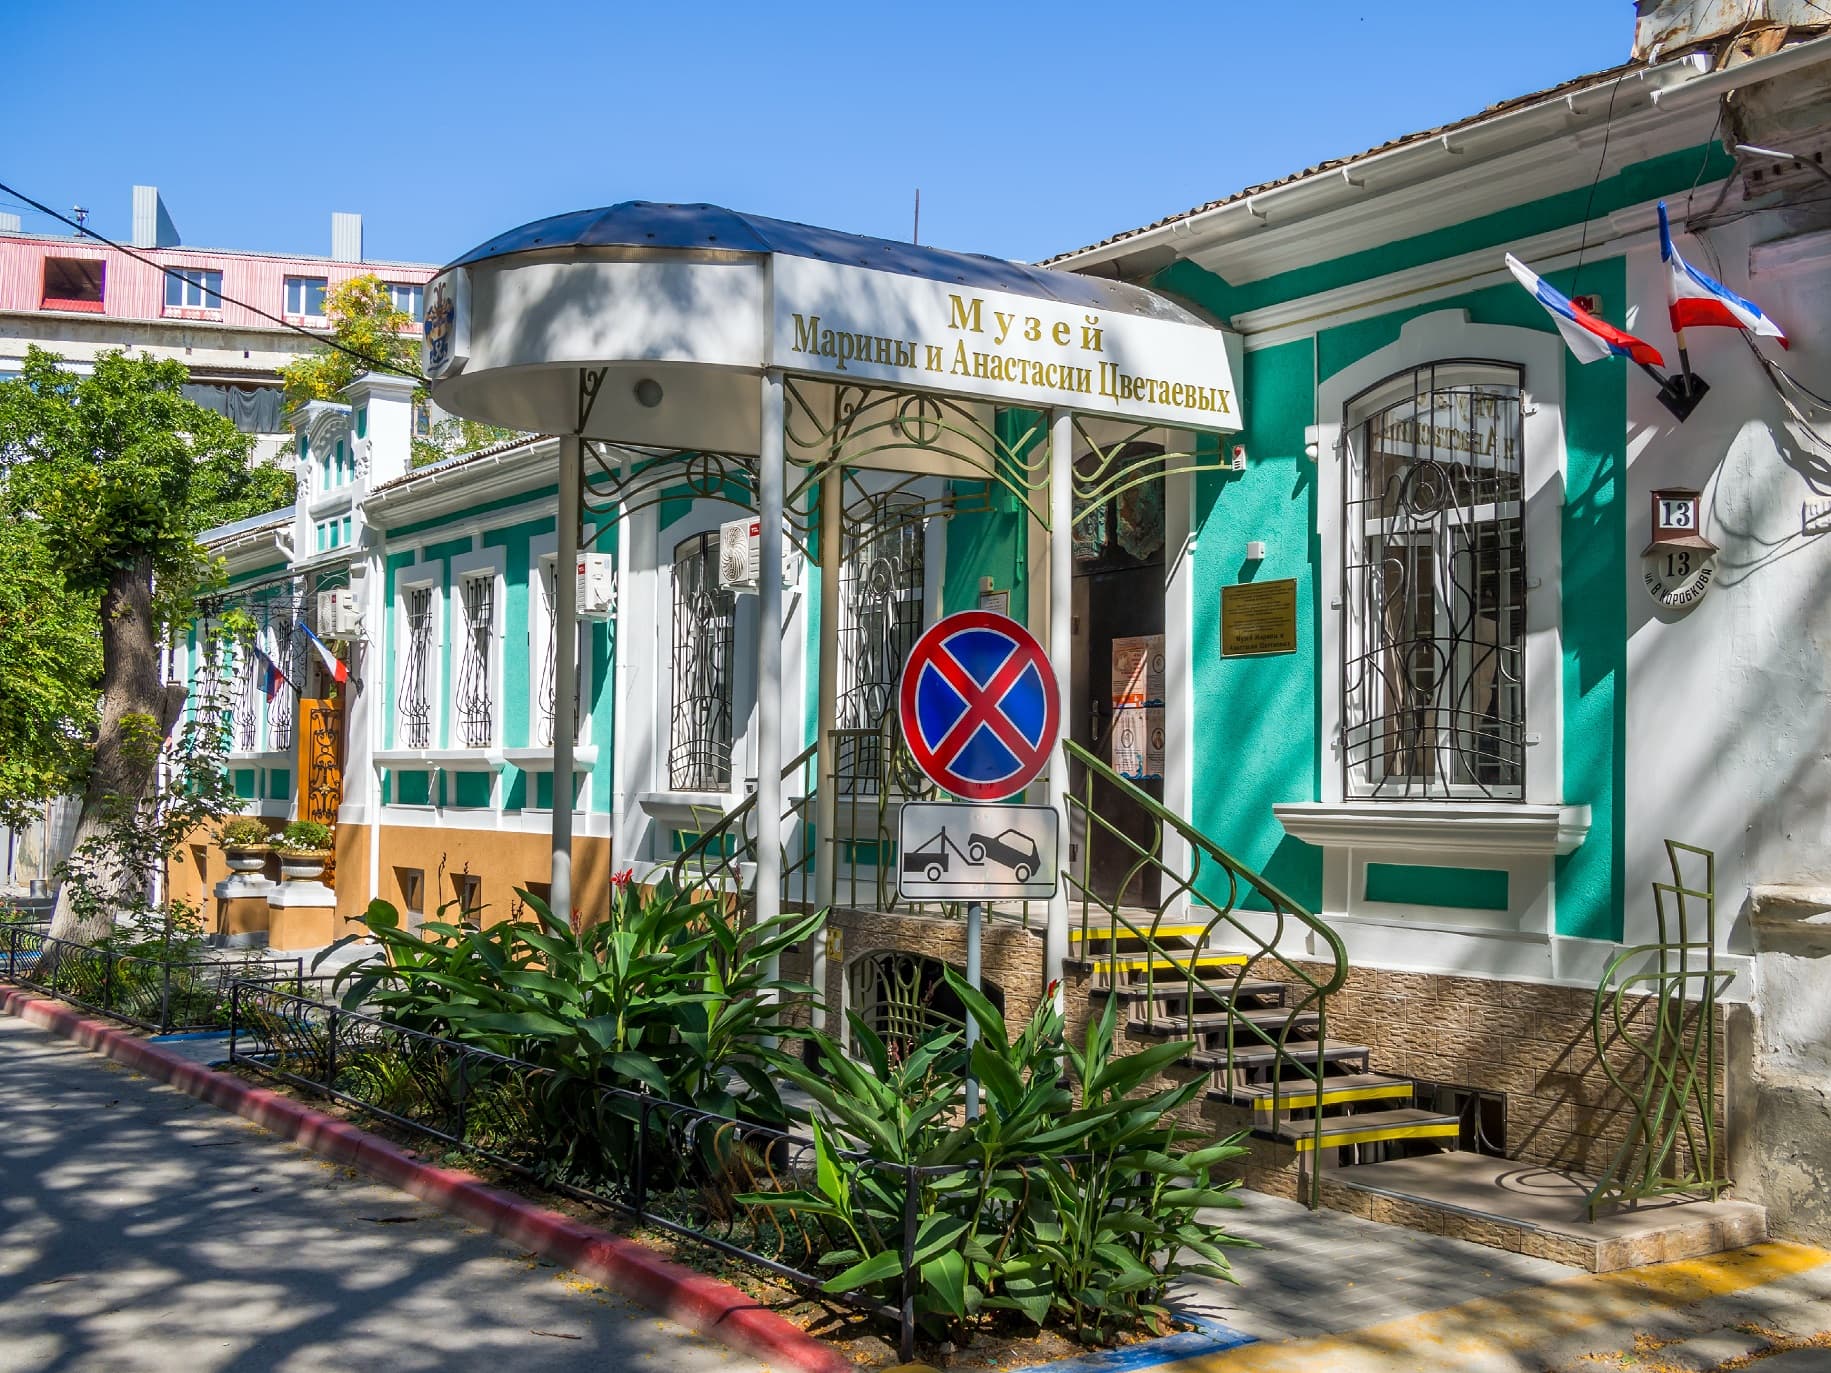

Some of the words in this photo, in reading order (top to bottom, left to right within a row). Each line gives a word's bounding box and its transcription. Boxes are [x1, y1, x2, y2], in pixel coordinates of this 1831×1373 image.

[948, 294, 1103, 352] Музей
[791, 313, 917, 370] Марины
[924, 344, 943, 372] и
[950, 339, 1092, 394] Анастасии
[1098, 361, 1230, 414] Цветаевых
[1662, 501, 1690, 527] 13
[1666, 551, 1690, 577] 13
